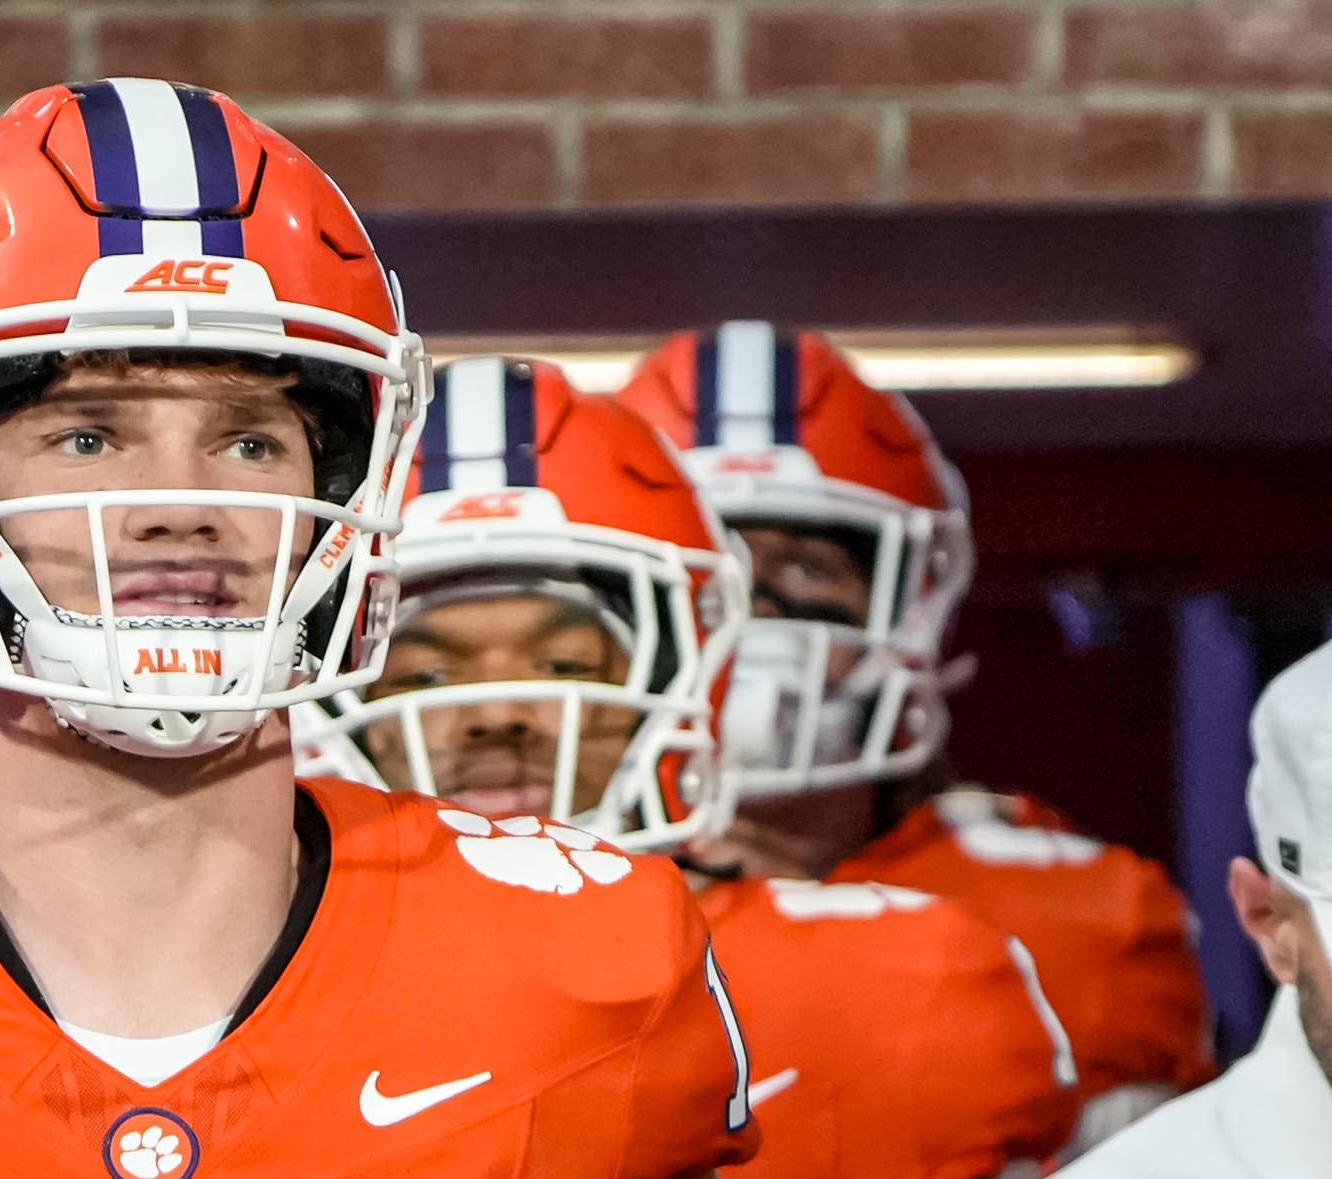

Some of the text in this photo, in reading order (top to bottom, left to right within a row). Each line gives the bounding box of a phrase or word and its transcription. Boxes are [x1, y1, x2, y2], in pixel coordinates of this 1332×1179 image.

[125, 260, 234, 293] ACC
[134, 648, 222, 676] ALL IN
